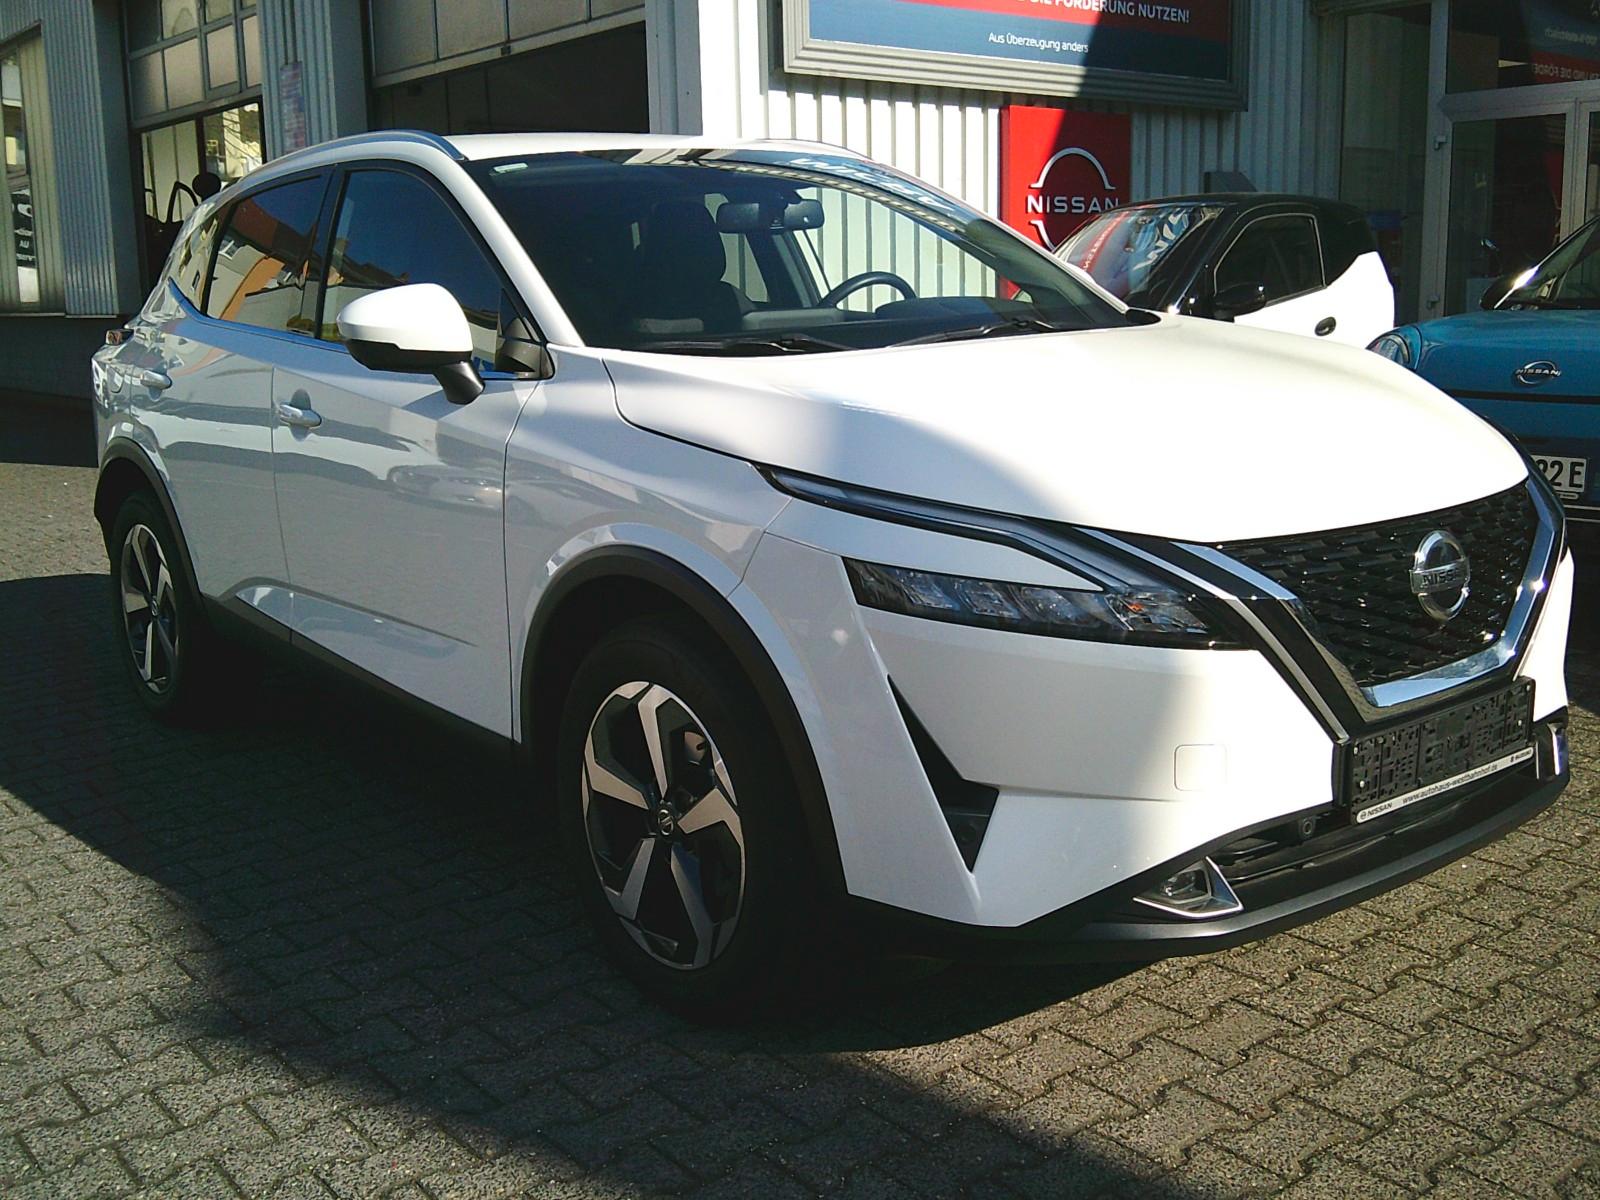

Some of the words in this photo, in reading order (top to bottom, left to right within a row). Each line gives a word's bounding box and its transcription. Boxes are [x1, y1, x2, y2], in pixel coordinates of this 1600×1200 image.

[1138, 3, 1190, 23] NUTZEN!
[988, 32, 1005, 44] Aus
[1006, 32, 1060, 52] Überzeugung
[1061, 41, 1089, 53] anders
[1027, 194, 1119, 214] NISSAN
[1515, 368, 1562, 377] NISSAN
[1367, 802, 1393, 818] NISSAN
